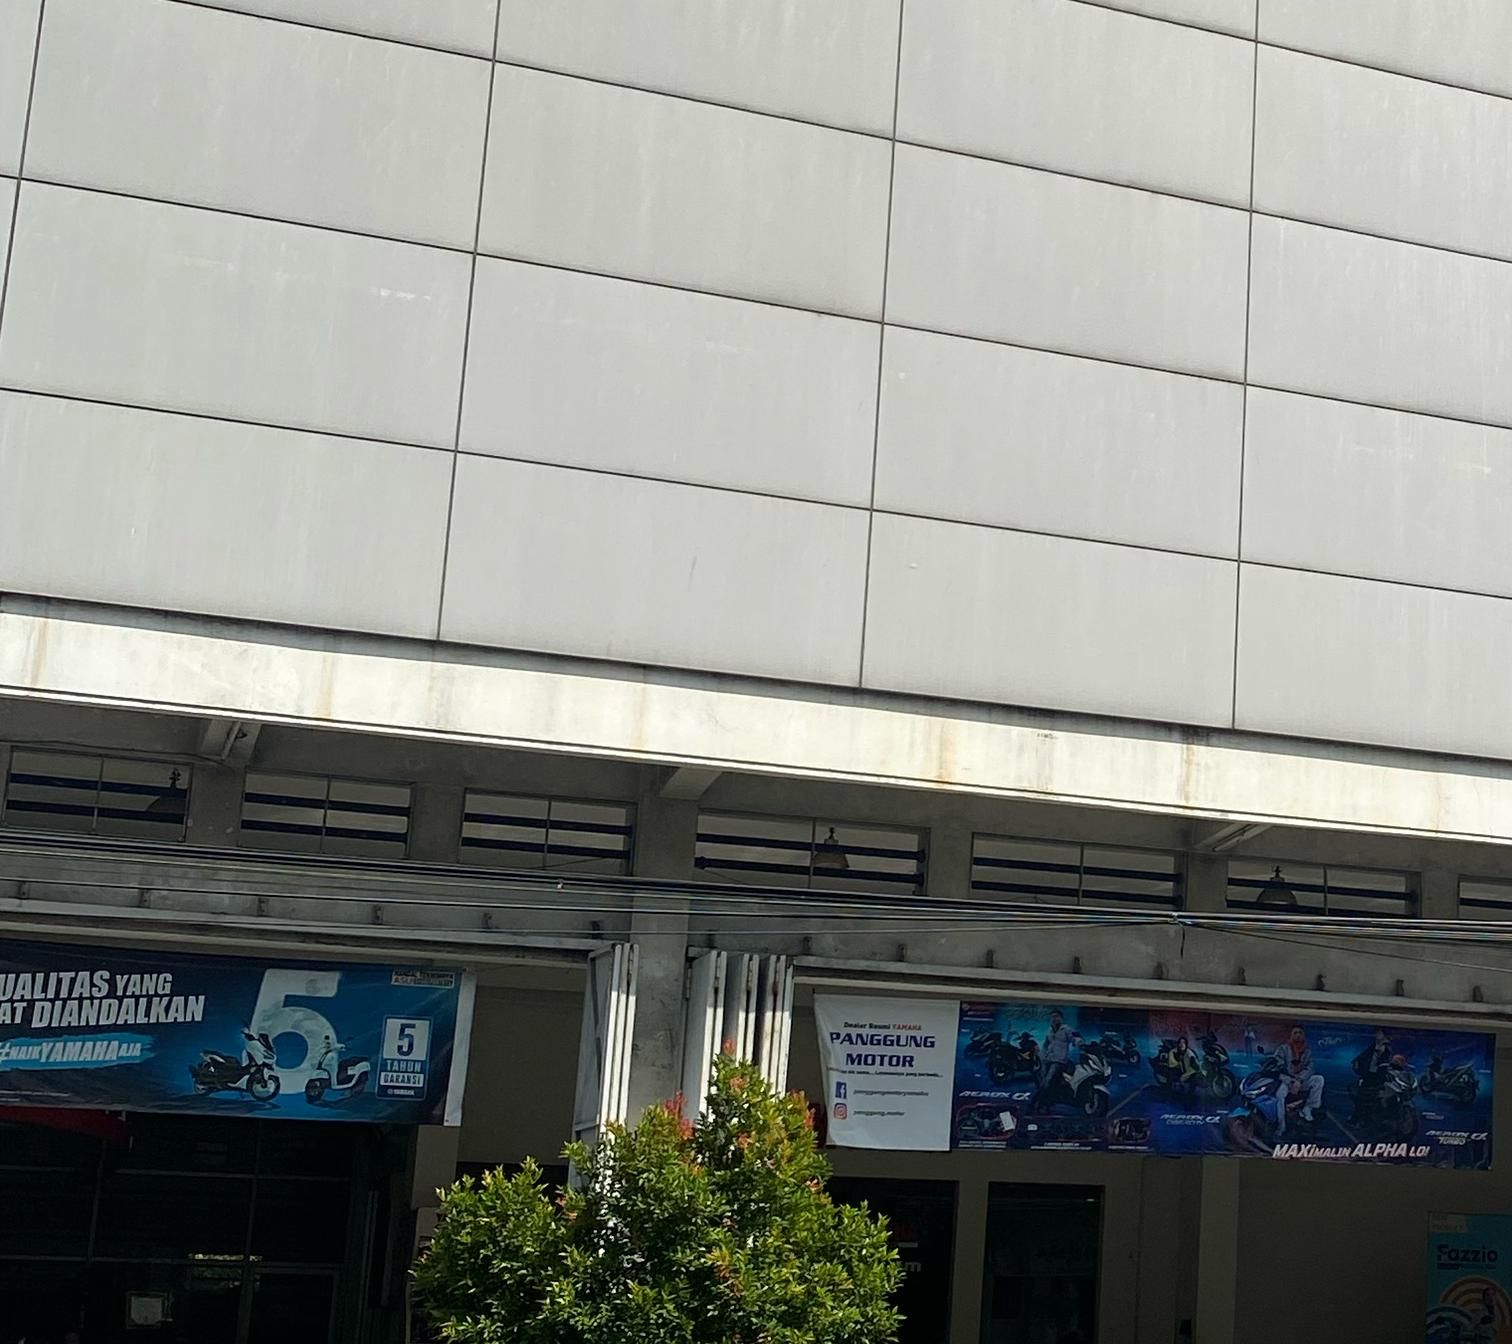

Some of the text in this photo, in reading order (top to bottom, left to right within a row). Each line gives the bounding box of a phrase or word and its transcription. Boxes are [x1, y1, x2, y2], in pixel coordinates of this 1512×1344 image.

[116, 973, 173, 996] YANG
[31, 995, 206, 1028] DIANDALKAN
[248, 968, 341, 1094] 5
[397, 1023, 416, 1056] 5
[829, 1032, 936, 1048] PANGGUNG
[386, 1060, 422, 1072] TAHUN
[845, 1053, 915, 1068] MOTOR
[1350, 1143, 1408, 1157] ALPHA
